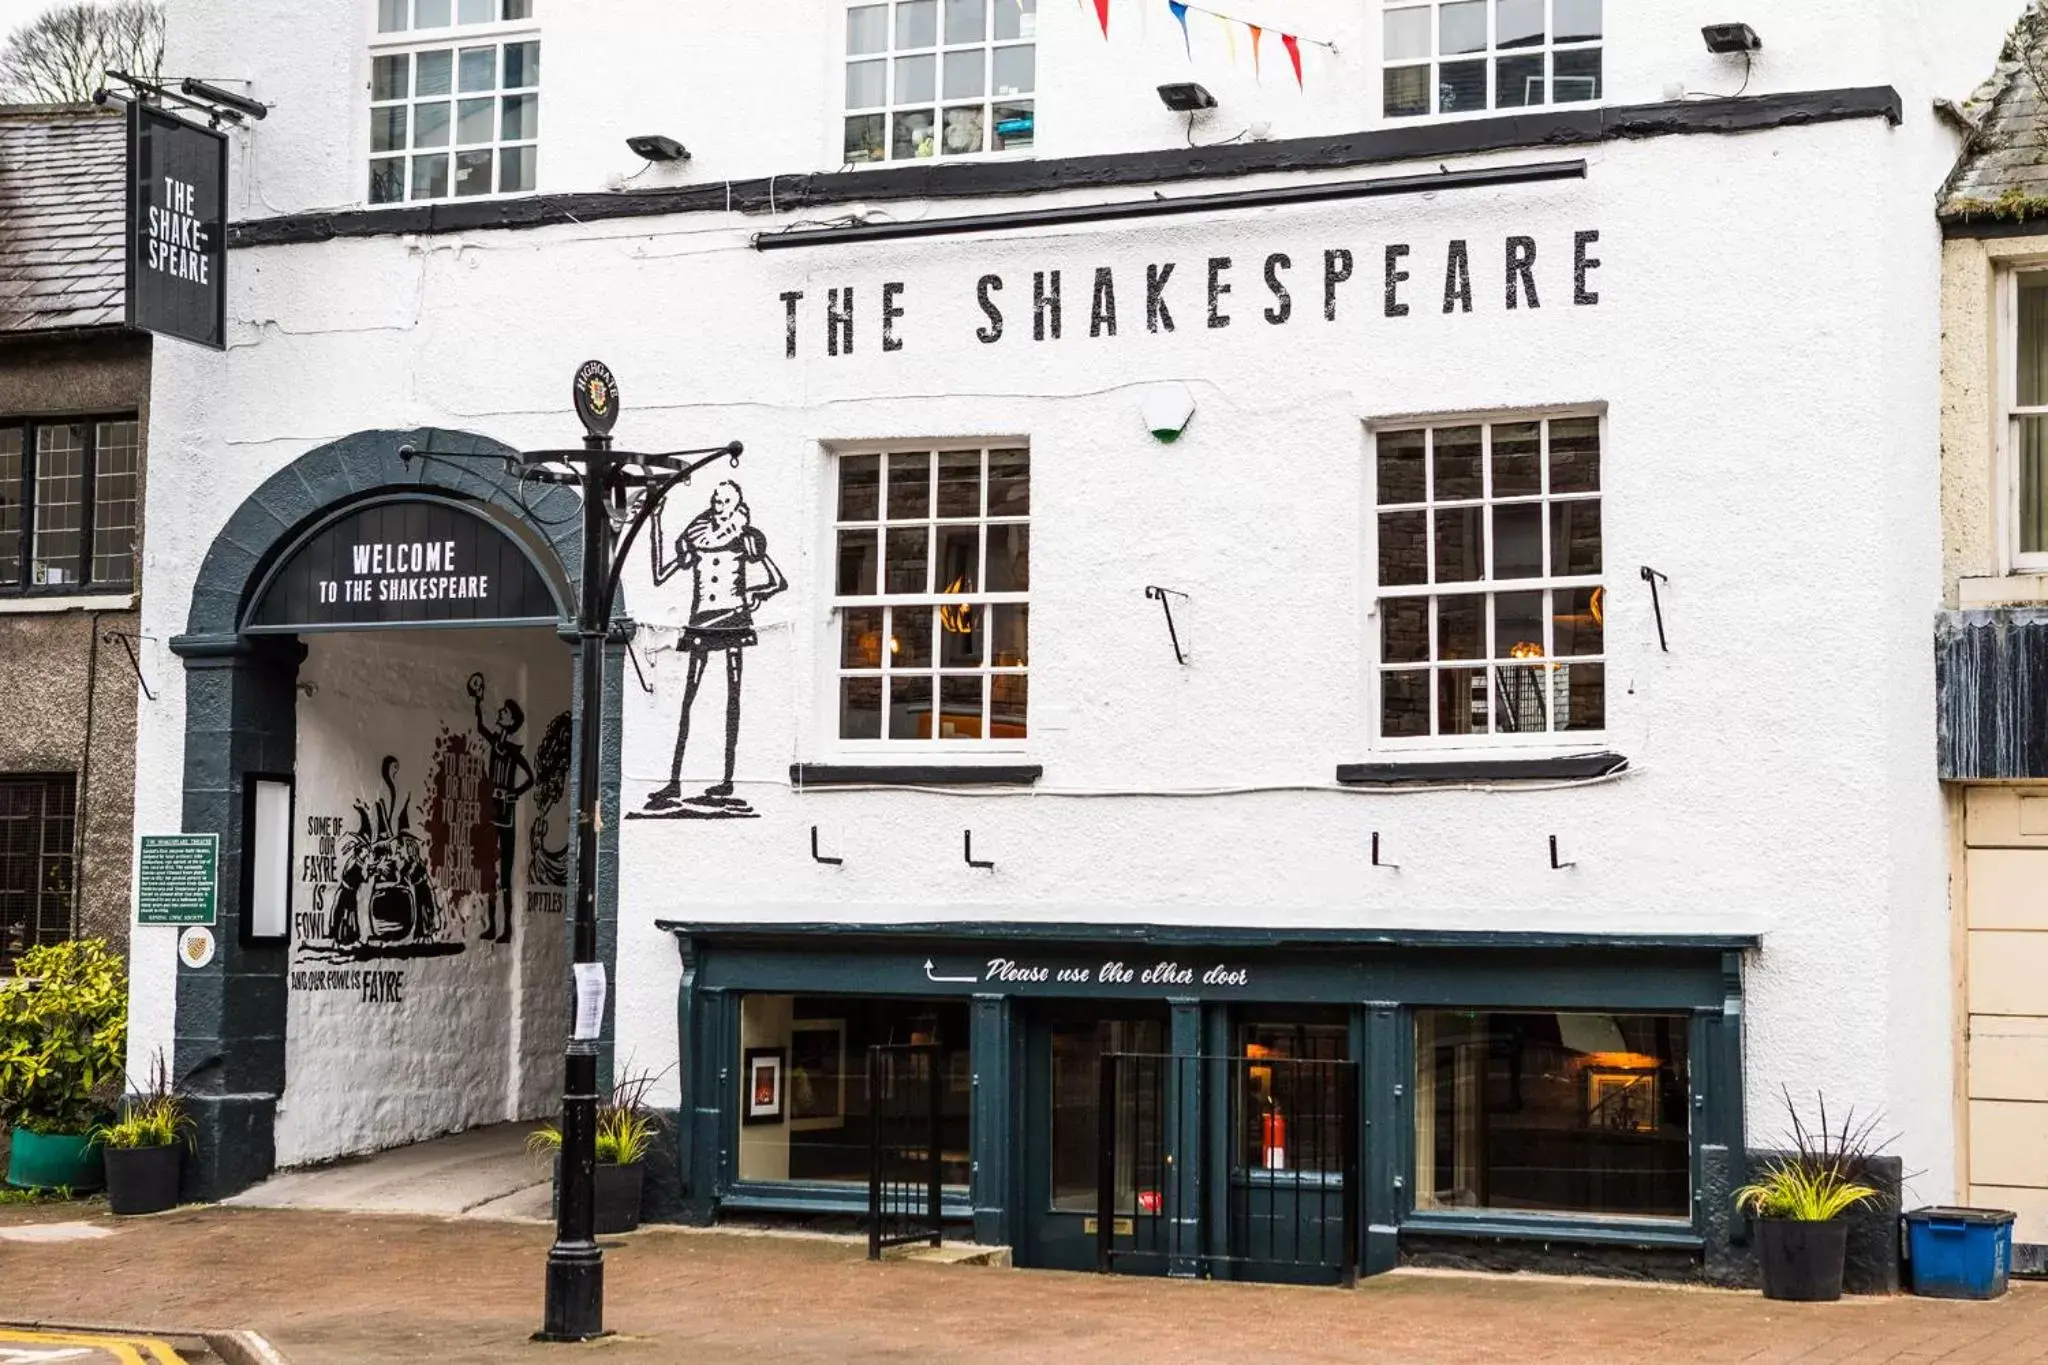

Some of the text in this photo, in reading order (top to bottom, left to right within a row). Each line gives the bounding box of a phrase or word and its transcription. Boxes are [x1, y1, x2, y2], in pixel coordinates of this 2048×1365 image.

[164, 176, 195, 217] THE
[149, 205, 209, 252] SHAKE-
[149, 238, 208, 286] SPEARE
[779, 229, 1601, 359] THE SHAKESPEARE
[577, 362, 619, 398] HIGHGATE
[353, 541, 456, 575] WELCOME
[319, 575, 488, 604] TO THE SHAKESPEARE
[308, 816, 344, 836] SOME OF
[319, 836, 336, 856] OUR
[302, 855, 338, 882] FAYRE
[312, 883, 327, 911] IS
[527, 891, 563, 913] BOTTLES
[295, 912, 331, 940] FOWL
[985, 957, 1248, 986] Please use the other door
[291, 970, 404, 1003] AND OUR FOWL IS FAYRE
